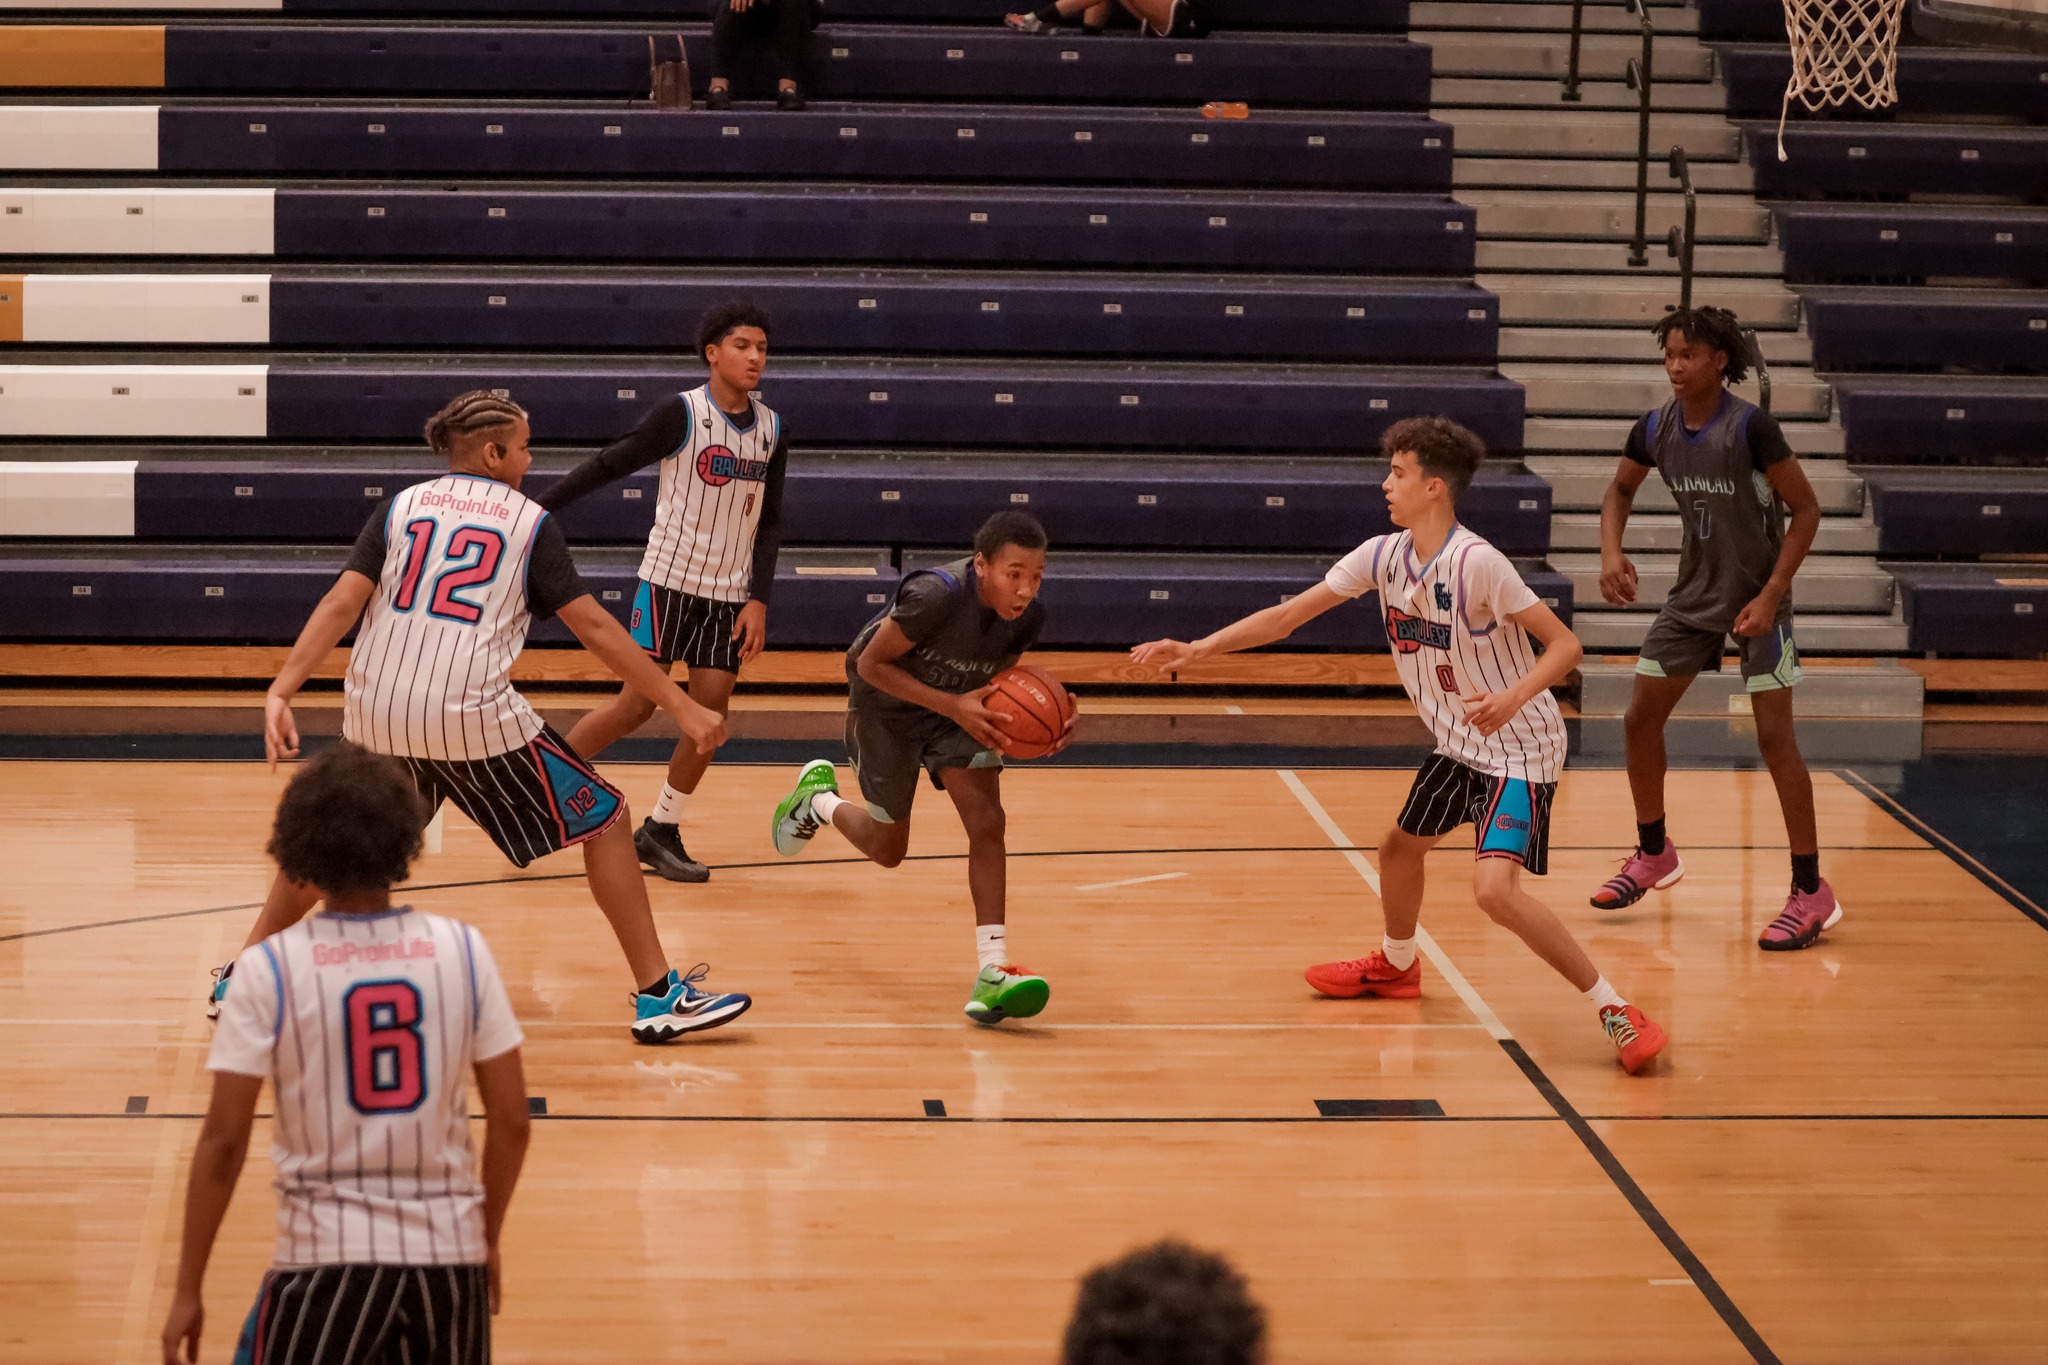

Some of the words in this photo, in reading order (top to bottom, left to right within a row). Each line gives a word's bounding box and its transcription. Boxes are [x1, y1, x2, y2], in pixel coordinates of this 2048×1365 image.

[420, 491, 510, 520] GoProInLife
[1694, 499, 1711, 539] 7
[392, 516, 508, 626] 12
[631, 608, 642, 629] 3
[1398, 621, 1451, 648] BALLER
[565, 785, 598, 818] 12
[312, 938, 436, 966] GoProInLife
[342, 978, 428, 1115] 6
